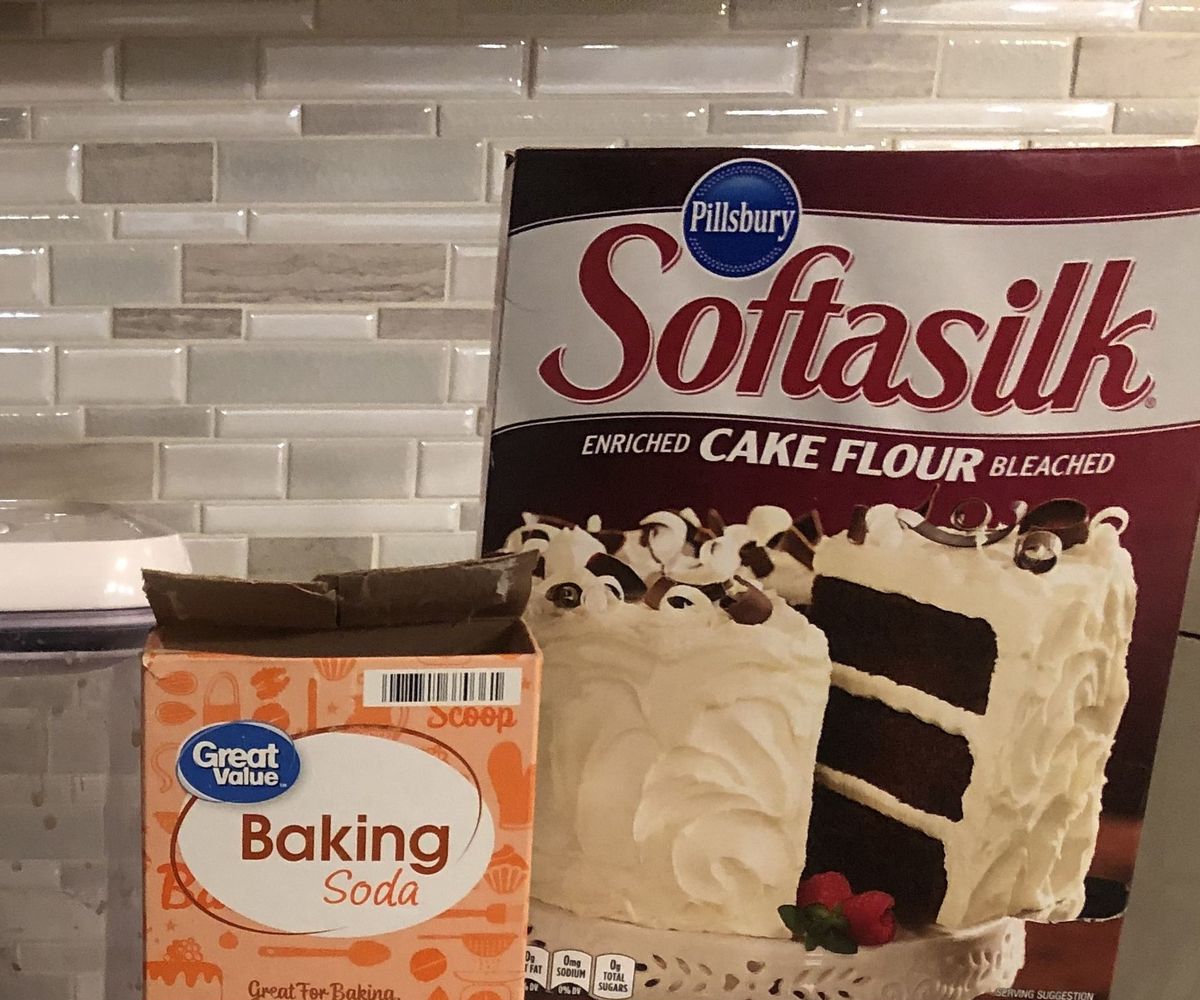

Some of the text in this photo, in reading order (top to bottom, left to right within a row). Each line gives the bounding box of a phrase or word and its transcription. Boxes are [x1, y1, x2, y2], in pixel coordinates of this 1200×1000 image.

[689, 198, 796, 243] Pillsbury
[538, 222, 1154, 417] Softasilk
[581, 428, 1116, 484] ENRICHED CAKE FLOUR BLEACHED
[191, 740, 280, 769] Great
[213, 767, 280, 787] Value
[241, 814, 450, 875] Baking
[323, 868, 419, 907] Soda
[563, 955, 582, 968] 0mg
[610, 959, 622, 972] 0g
[556, 966, 586, 979] SODIUM
[603, 971, 625, 982] TOTAL
[297, 981, 330, 1000] For
[598, 981, 628, 993] SUGARS
[995, 988, 1094, 1000] SERVING SUGGESTION
